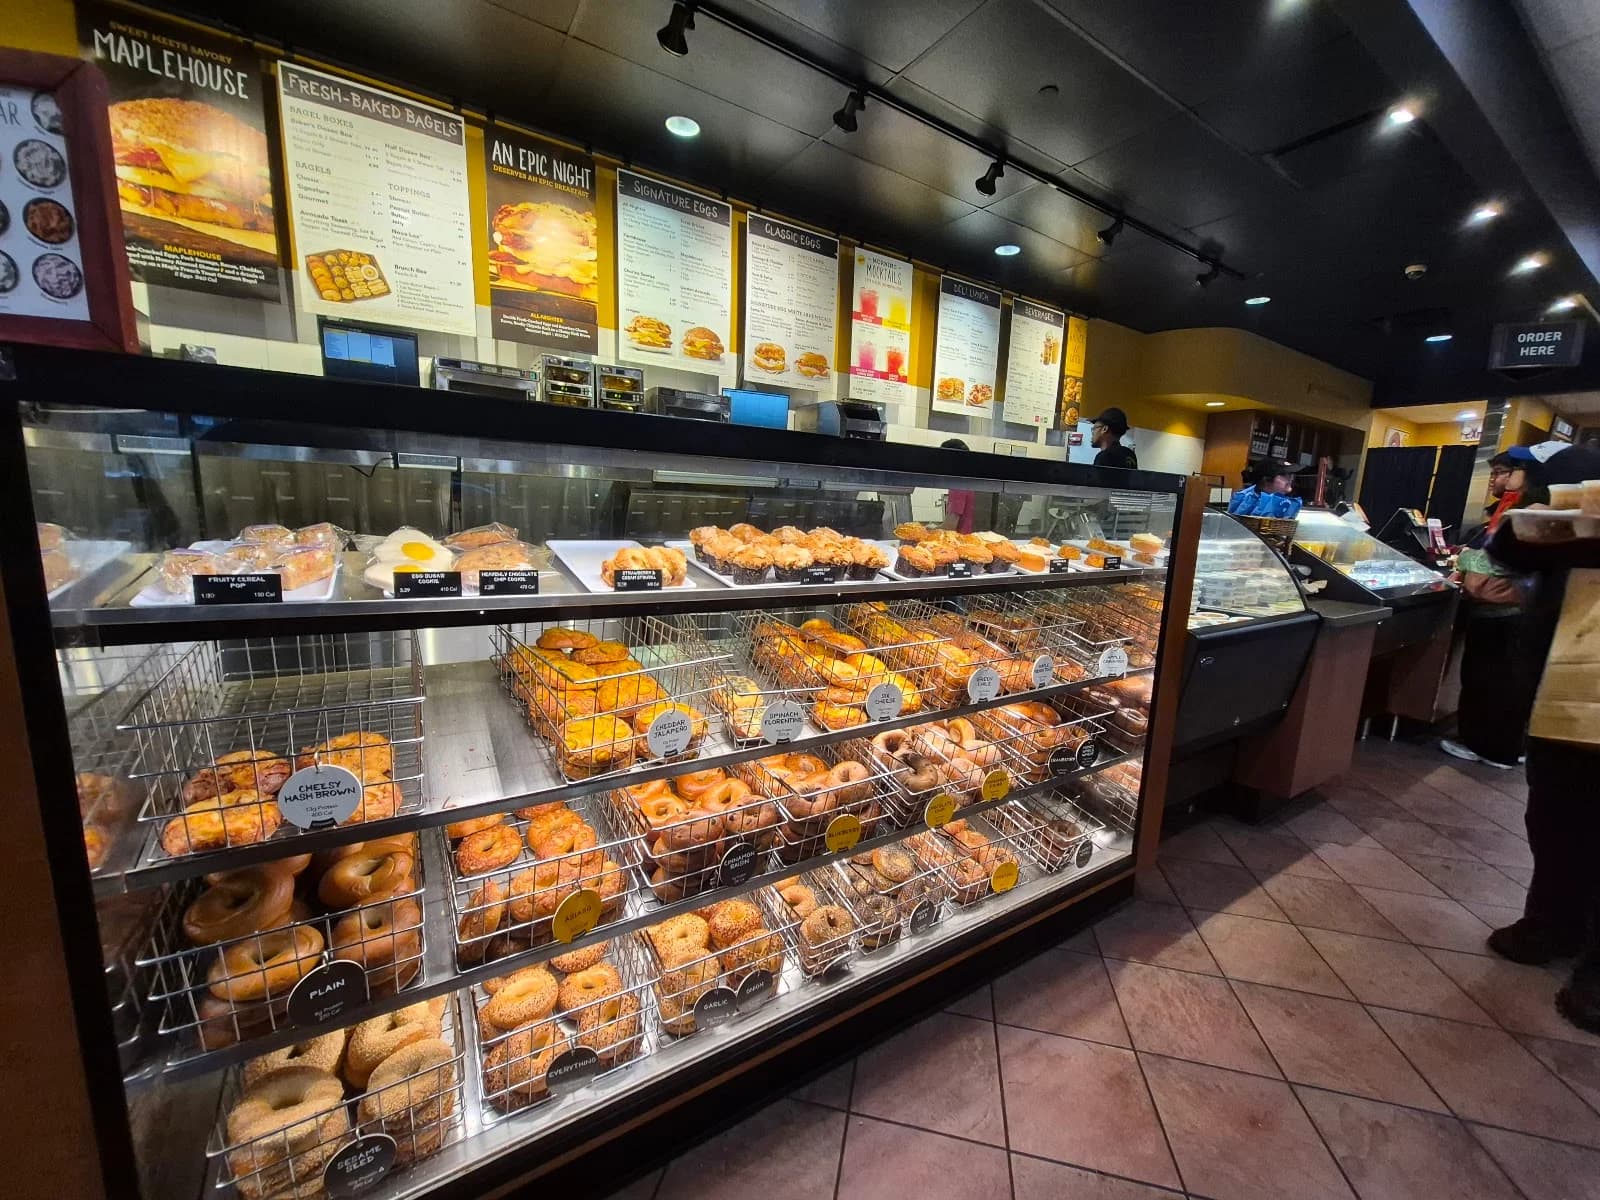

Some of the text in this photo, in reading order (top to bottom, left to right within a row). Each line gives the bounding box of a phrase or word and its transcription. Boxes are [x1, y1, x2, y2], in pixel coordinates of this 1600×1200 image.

[151, 33, 188, 52] MEETS
[190, 42, 232, 64] SAVORY
[93, 28, 249, 99] MAPLEHOUSE
[288, 73, 457, 137] FRESH-BAKED BAGELS
[290, 106, 354, 129] BAGEL BOXES
[295, 161, 331, 175] BAGELS
[492, 140, 592, 190] AN EPIC NIGHT
[493, 164, 590, 198] DESERVES AN EPIC BREAKFAST
[387, 183, 431, 198] TOPPINGS
[633, 180, 718, 218] SIGNATURE EGGS
[300, 210, 348, 224] Avocado Toast
[765, 222, 821, 249] CLASSIC EGGS
[164, 244, 222, 261] MAPLEHOUSE
[866, 264, 902, 286] MOCKTAILS
[969, 288, 989, 302] LUNCH
[1025, 306, 1055, 322] BEVERAGES
[1517, 331, 1562, 343] ORDER
[1520, 345, 1556, 357] HERE
[764, 717, 804, 726] FLORENTINE
[769, 711, 799, 719] SPINACH
[655, 719, 686, 732] CHEDDAR
[284, 786, 356, 804] HASH BROWN
[298, 780, 341, 793] CHEESY
[564, 904, 592, 922] ASIAGO
[309, 978, 345, 1000] PLAIN
[746, 981, 765, 994] ONION
[703, 999, 729, 1010] GARLIC
[548, 1056, 597, 1078] EVERYTHING
[336, 1144, 382, 1170] SESAME
[345, 1155, 374, 1173] SEED
